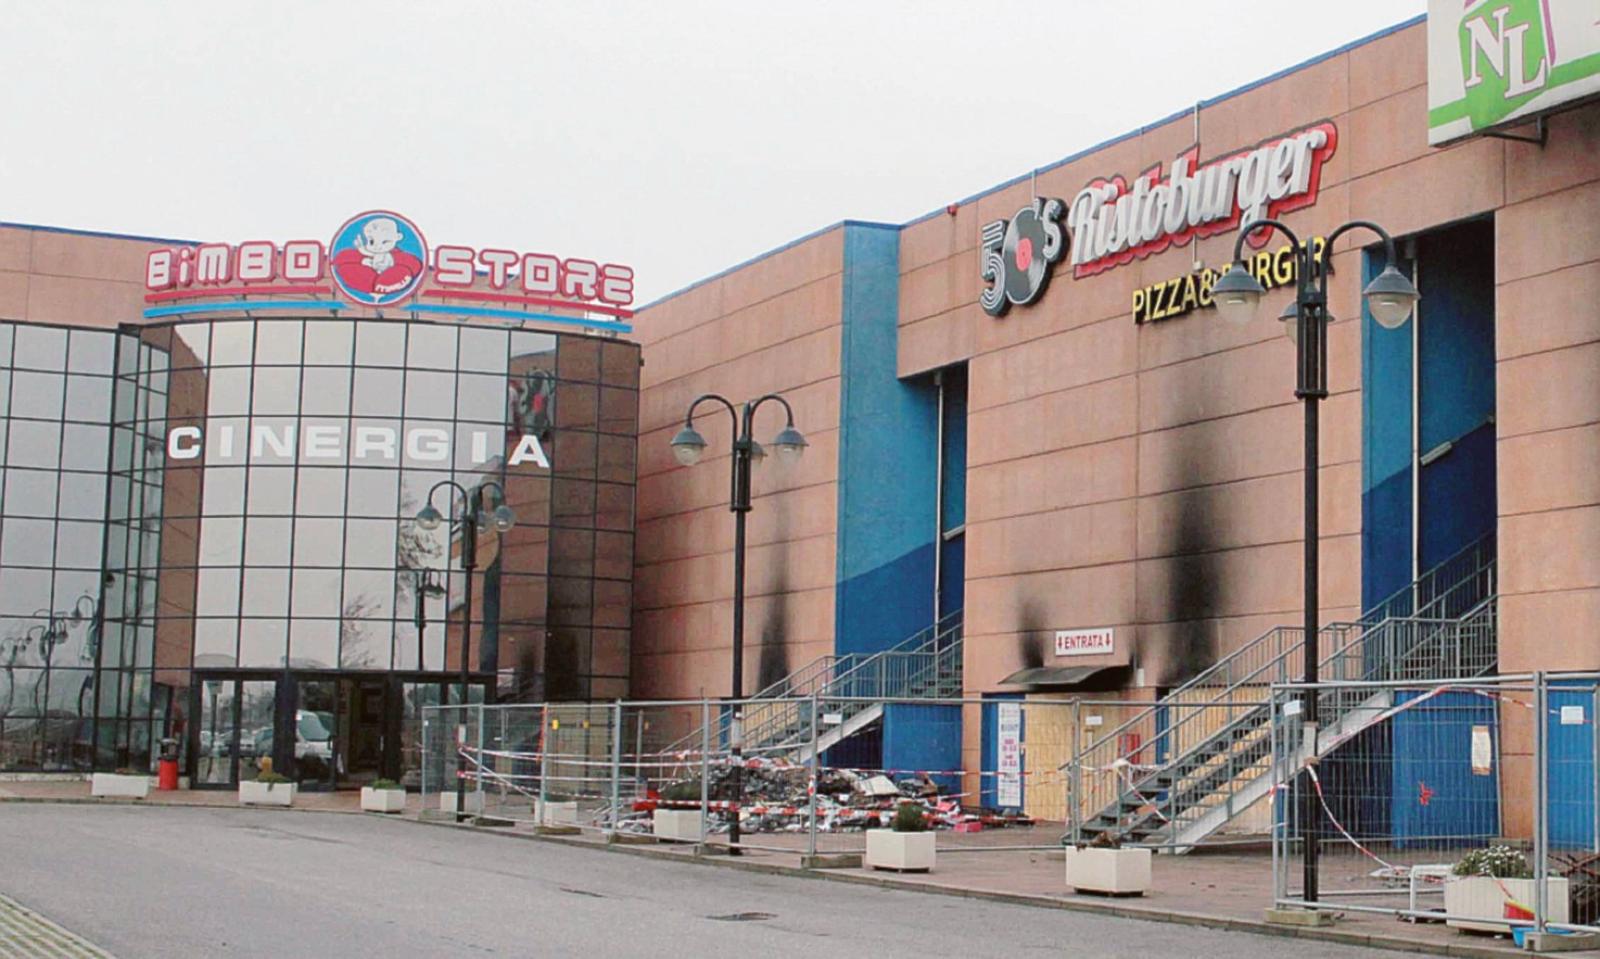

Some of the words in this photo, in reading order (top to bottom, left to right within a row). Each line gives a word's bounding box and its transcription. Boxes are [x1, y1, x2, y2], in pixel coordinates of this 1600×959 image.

[1465, 6, 1547, 99] NL
[1068, 129, 1328, 266] Ristoburger
[434, 245, 634, 305] STORE
[168, 424, 551, 469] CINERGIA
[1064, 634, 1104, 650] ENTRATA
